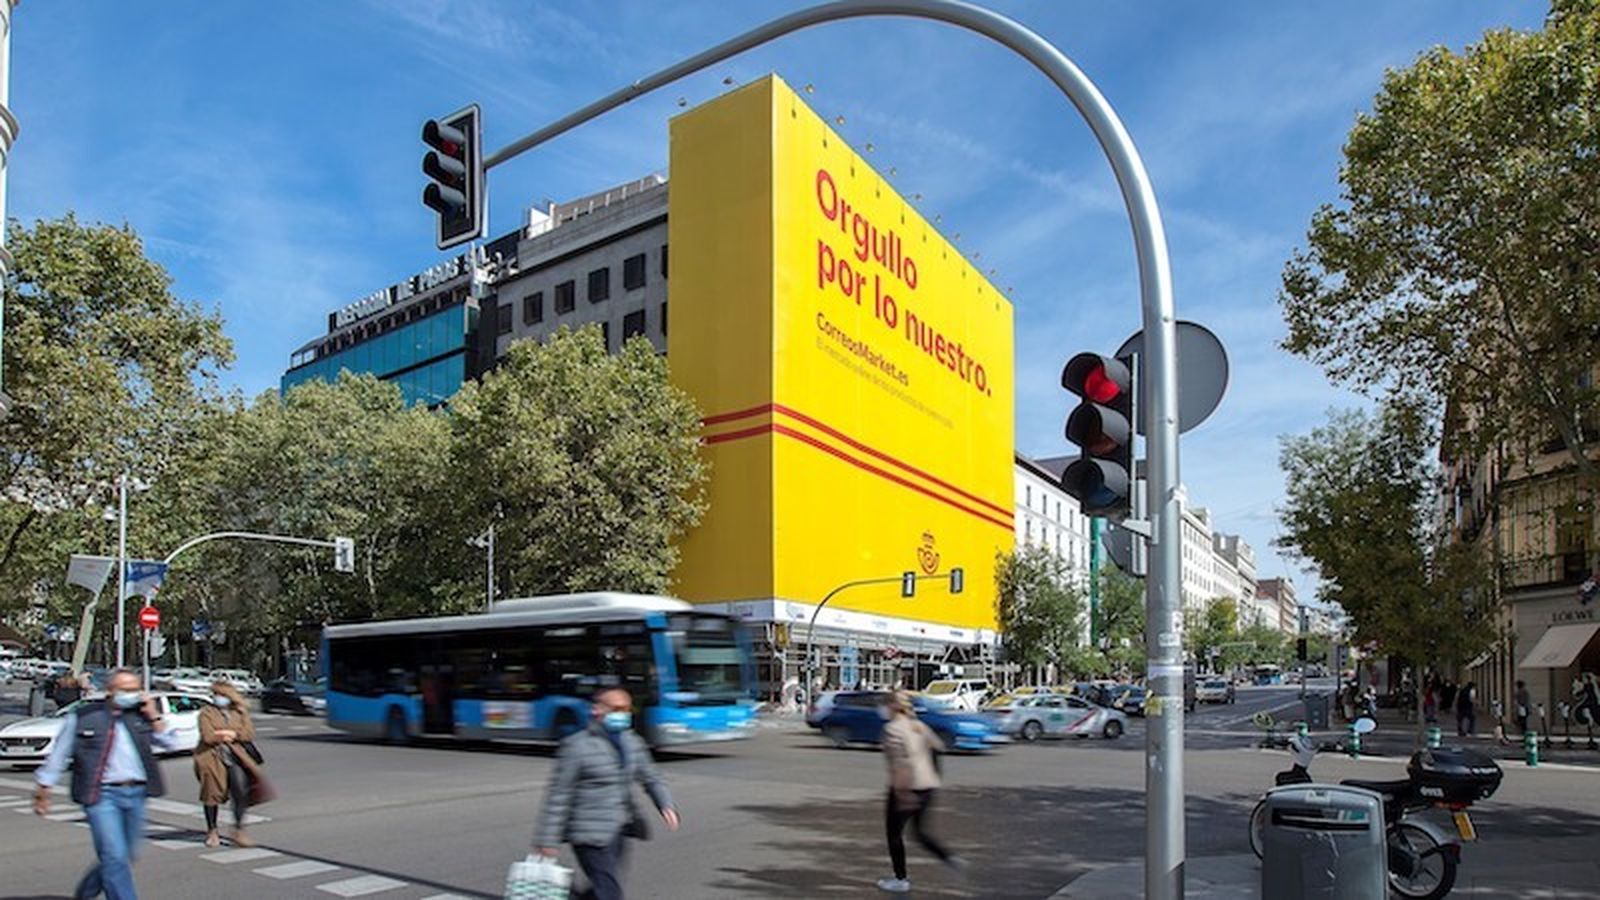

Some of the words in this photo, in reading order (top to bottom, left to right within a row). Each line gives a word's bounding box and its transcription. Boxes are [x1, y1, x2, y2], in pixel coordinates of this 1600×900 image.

[816, 169, 917, 290] Orgullo
[816, 312, 908, 387] CorreosMarket.es
[818, 239, 867, 306] por
[875, 274, 898, 329] lo
[905, 309, 992, 397] nuestro.
